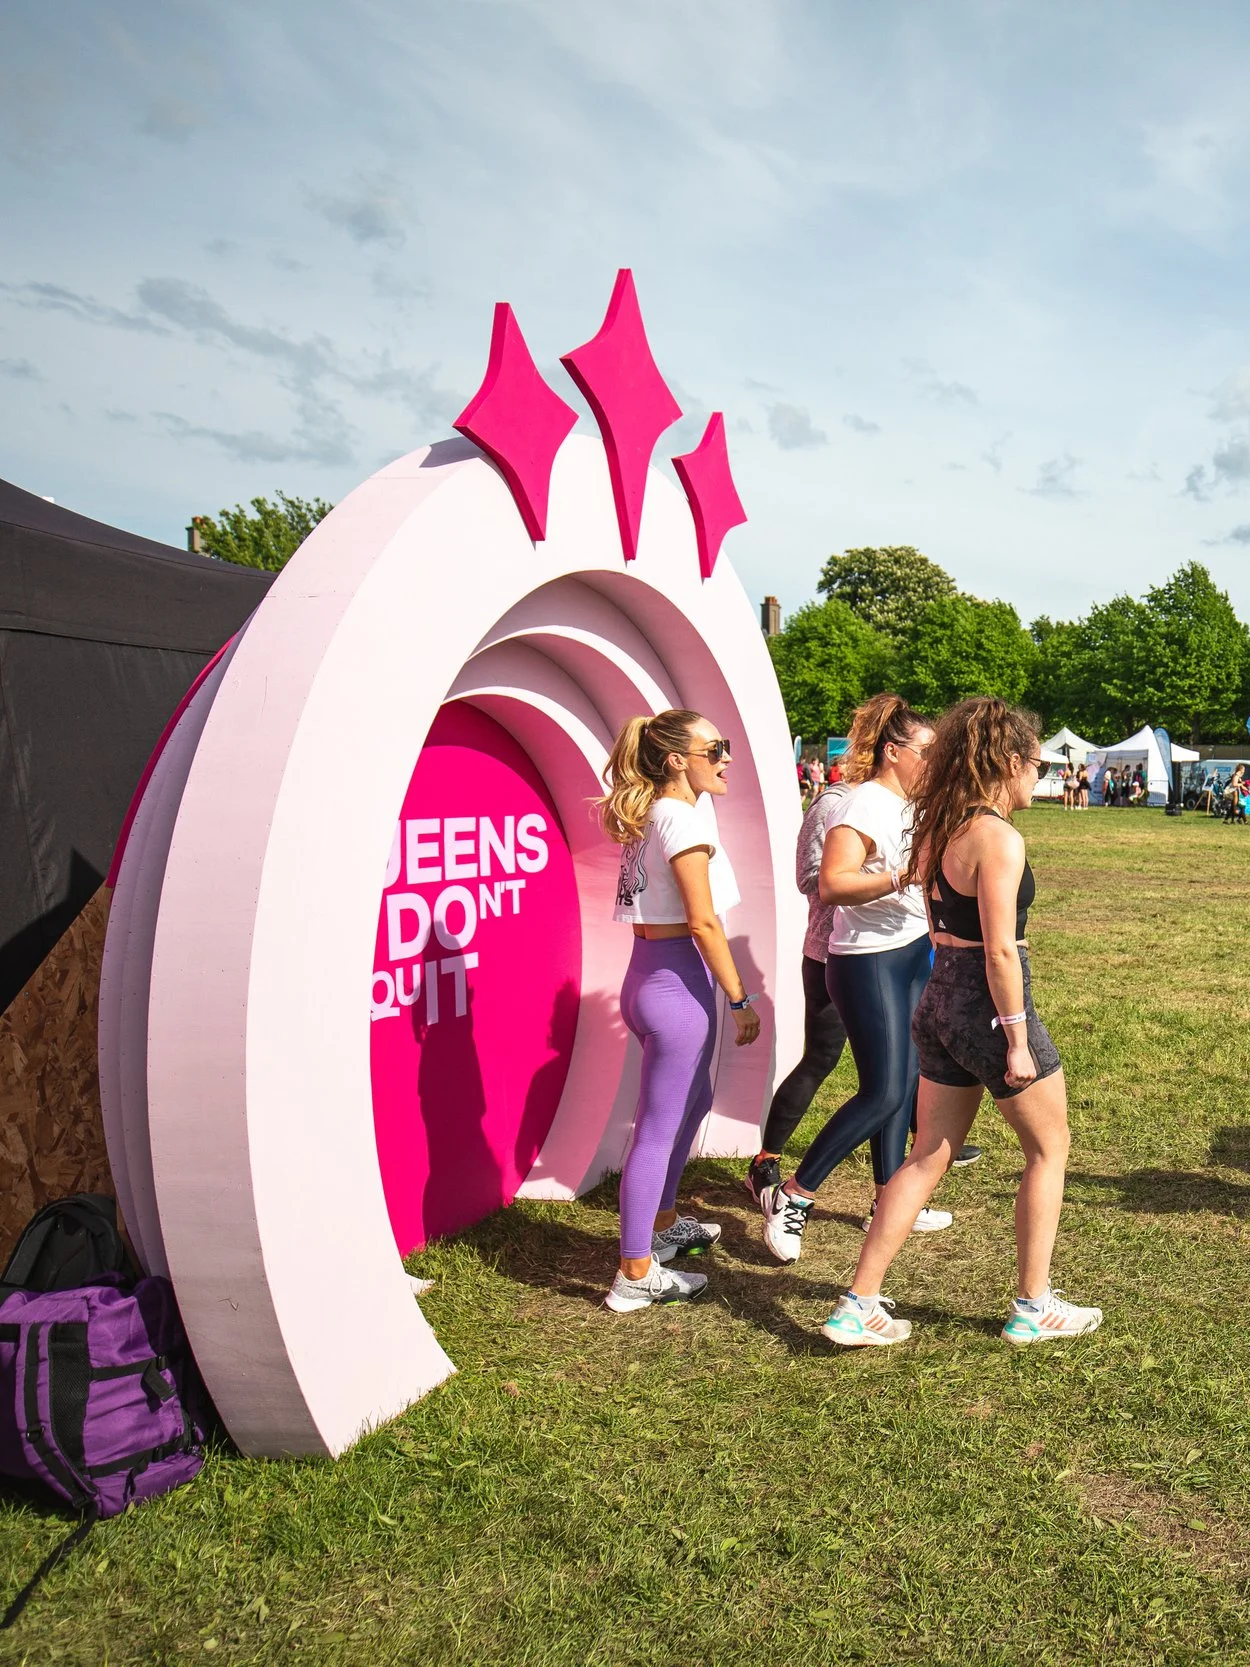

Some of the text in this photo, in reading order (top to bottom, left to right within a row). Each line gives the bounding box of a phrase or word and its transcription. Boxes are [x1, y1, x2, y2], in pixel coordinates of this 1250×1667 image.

[384, 813, 549, 889] UEENS
[386, 879, 526, 962] DON'T
[370, 952, 479, 1026] QUIT
